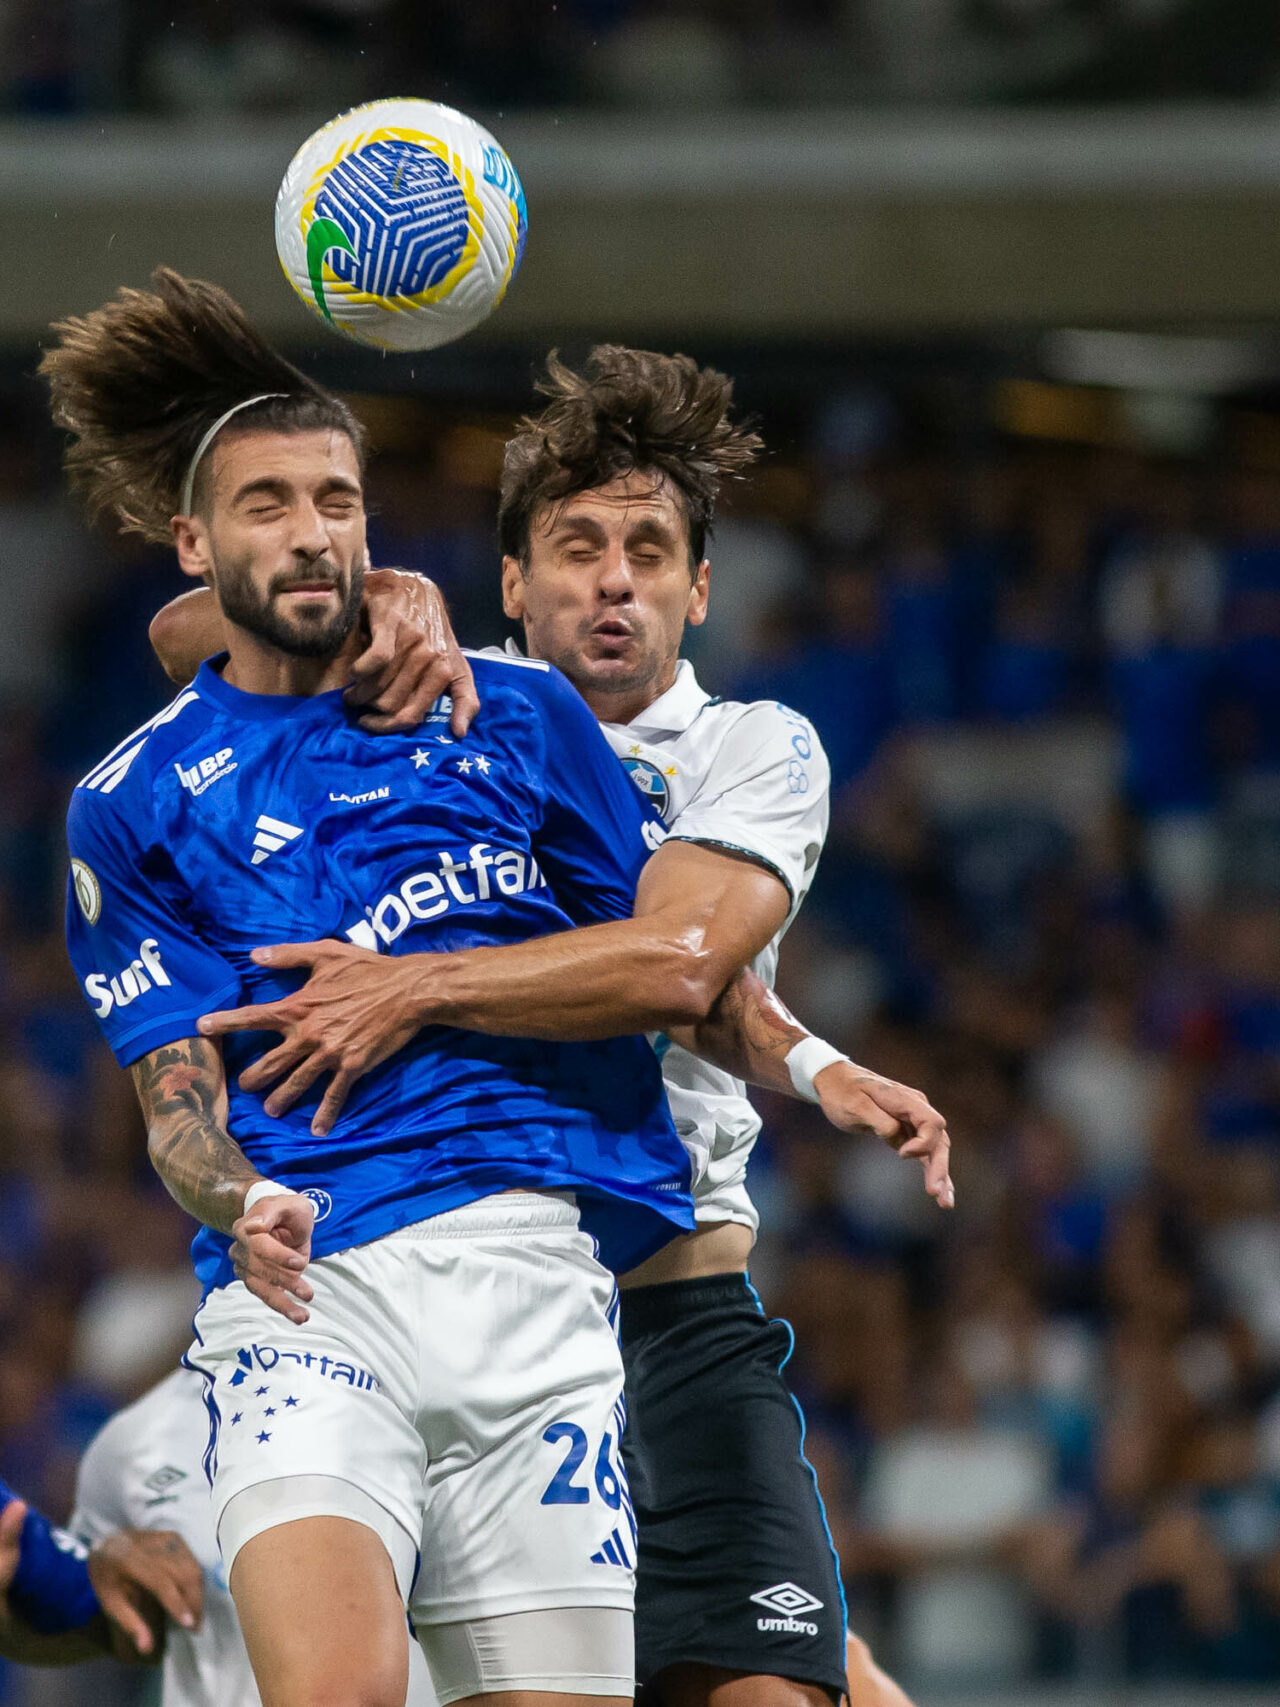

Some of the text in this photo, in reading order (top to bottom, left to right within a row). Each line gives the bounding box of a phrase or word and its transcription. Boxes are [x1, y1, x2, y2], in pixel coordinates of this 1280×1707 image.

[85, 938, 172, 1019] Surf
[540, 1421, 622, 1511] 26
[757, 1617, 818, 1636] umbro
